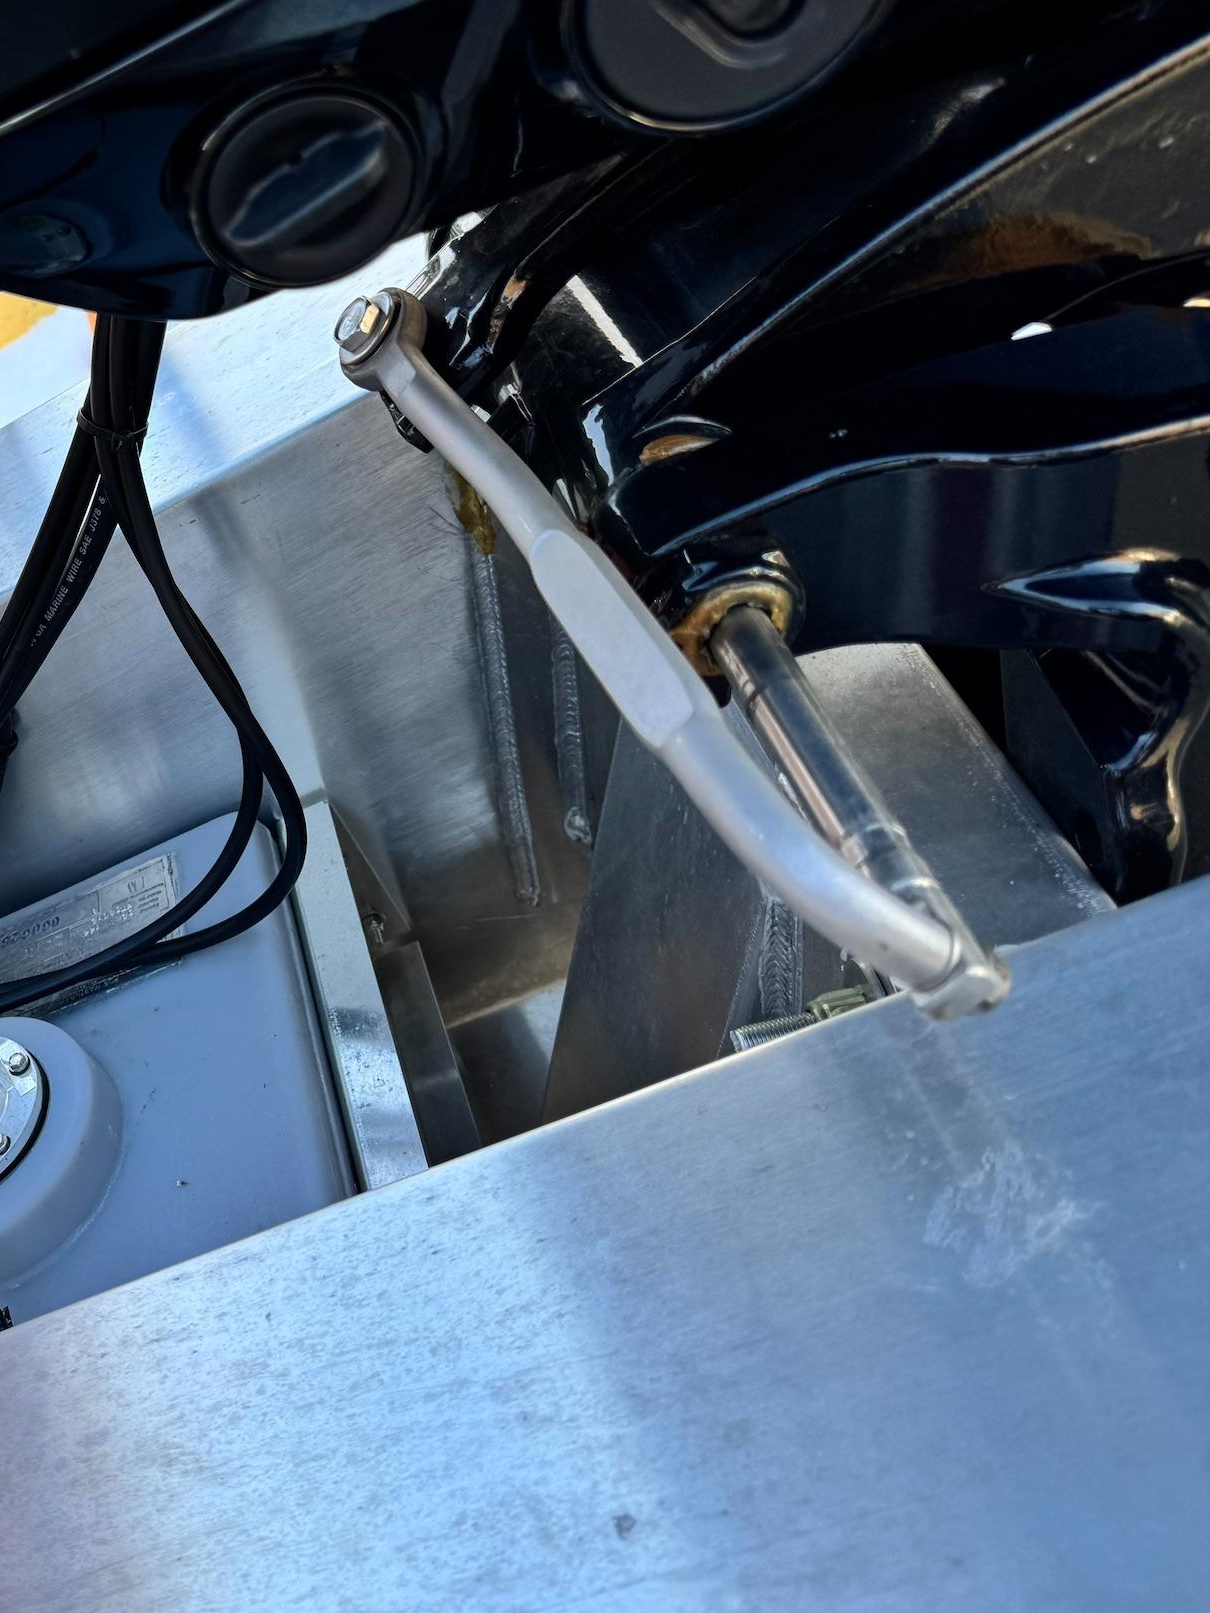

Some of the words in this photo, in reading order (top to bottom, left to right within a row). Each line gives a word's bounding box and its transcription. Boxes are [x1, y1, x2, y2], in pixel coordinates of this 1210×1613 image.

[44, 585, 69, 622] MARINE
[66, 557, 82, 584] WIRE
[79, 534, 92, 555] SAE
[89, 507, 102, 532] J378
